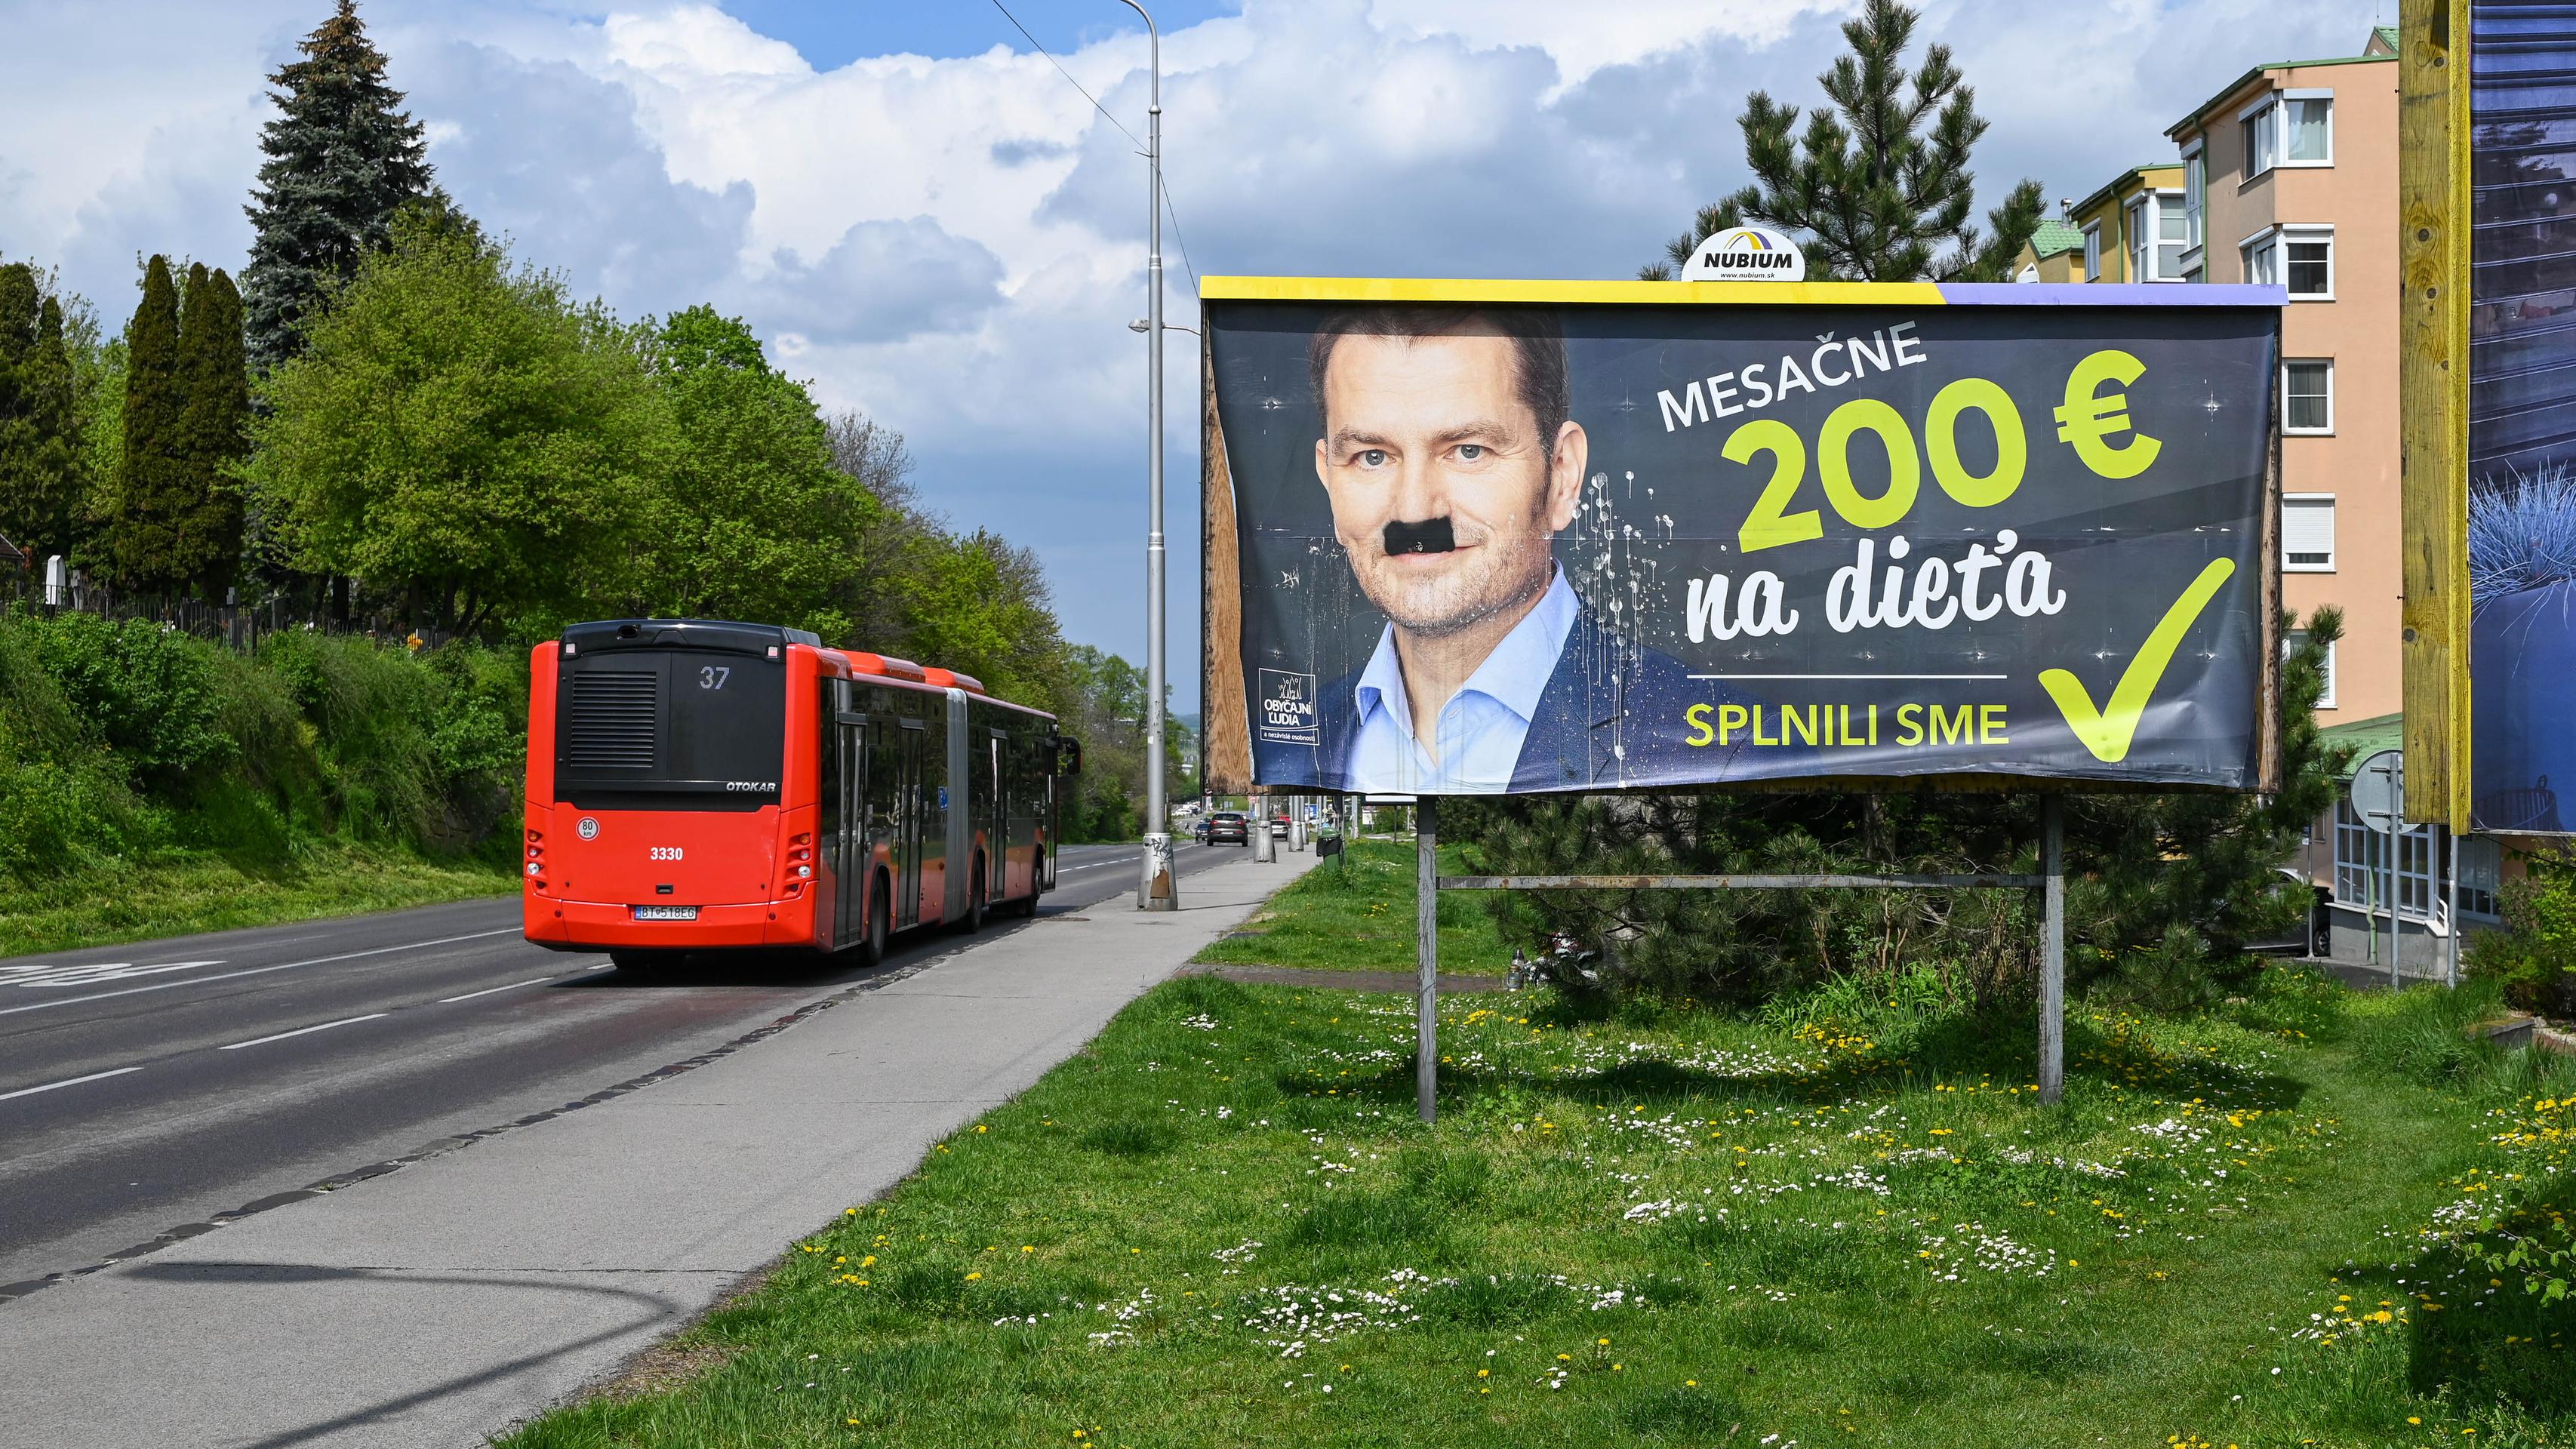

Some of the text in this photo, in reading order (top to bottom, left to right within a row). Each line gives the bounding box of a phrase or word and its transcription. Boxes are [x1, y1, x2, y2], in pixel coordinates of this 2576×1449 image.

[1704, 253, 1793, 269] NUBIUM
[1657, 320, 1928, 432] MESAČNE
[1721, 349, 2162, 553] 200 €
[1686, 529, 2067, 643] na dieťa
[700, 666, 731, 690] 37
[1263, 699, 1312, 715] OBYČAJNÍ
[1268, 711, 1300, 726] ĽUDIA
[1685, 703, 2010, 747] SPLNILI SME
[725, 782, 777, 792] OTOKAR
[582, 821, 593, 830] 80
[650, 847, 684, 860] 3330
